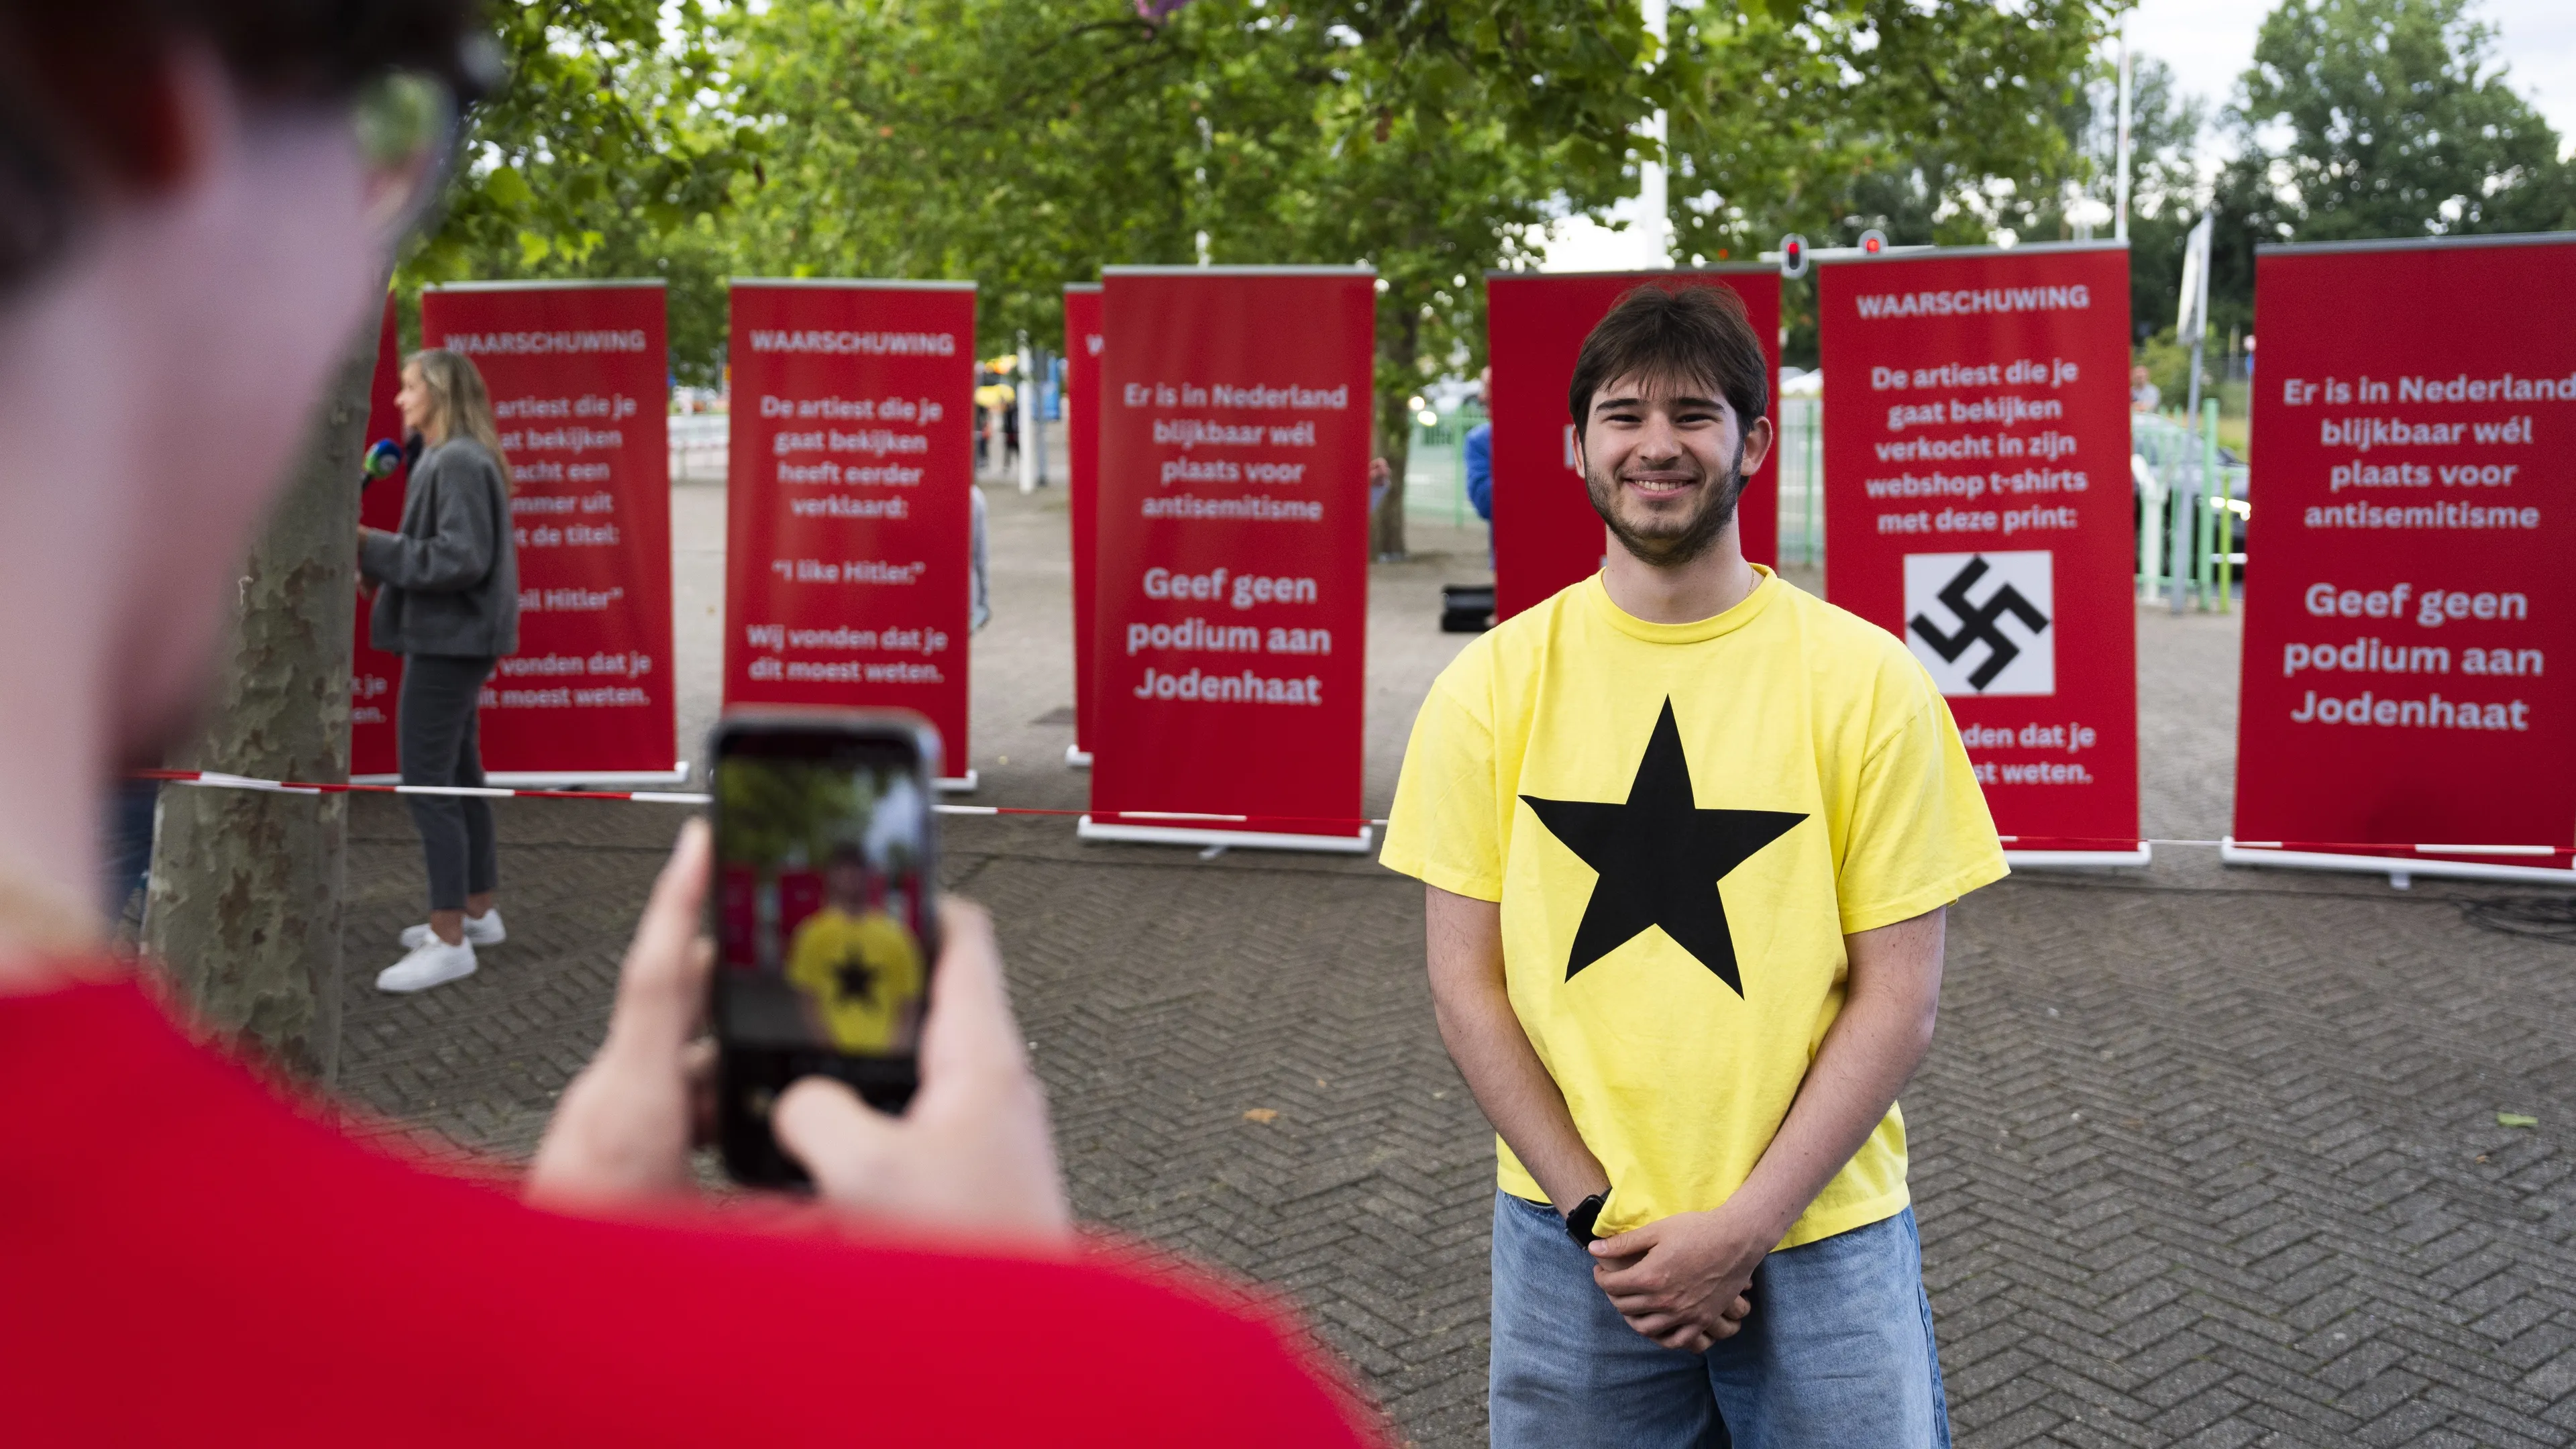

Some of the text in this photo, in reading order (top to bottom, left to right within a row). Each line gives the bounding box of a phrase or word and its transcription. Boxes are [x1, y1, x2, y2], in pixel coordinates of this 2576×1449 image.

[1856, 284, 2091, 319] WAARSCHUWING
[443, 330, 647, 354] WAARSCHUWING
[749, 330, 955, 356] WAARSCHUWING
[1871, 357, 2080, 390] De artiest die je
[1123, 382, 1348, 410] Er is in Nederland
[2283, 372, 2576, 405] Er is in Nederland
[492, 394, 637, 421] artiest die je
[759, 394, 943, 426] De artiest die je
[1887, 395, 2063, 434] gaat bekijken
[500, 427, 623, 454] at bekijken
[773, 429, 928, 458] gaat bekijken
[1152, 419, 1316, 449] blijkbaar wél
[1875, 431, 2077, 462] verkocht in zijn
[2320, 415, 2532, 452] blijkbaar wél
[512, 460, 610, 483] acht een
[777, 460, 924, 486] heeft eerder
[1161, 456, 1306, 485] plaats voor
[1865, 467, 2089, 500] webshop t-shirts
[2330, 459, 2518, 492] plaats voor
[511, 491, 614, 516] mmer uit
[789, 494, 908, 519] verklaard:
[1141, 493, 1324, 521] antisemitisme
[2304, 500, 2540, 529] antisemitisme
[1877, 504, 2078, 535] met deze print:
[531, 525, 562, 547] de
[564, 523, 619, 546] titel:
[795, 558, 841, 584] like
[1143, 567, 1318, 610] Geef geen
[2305, 582, 2528, 627] Geef geen
[746, 624, 949, 655] Wij vonden dat je
[1127, 617, 1332, 655] podium aan
[499, 650, 652, 679] vonden dat je
[748, 656, 944, 683] dit moest weten.
[2283, 637, 2544, 677] podium aan
[477, 686, 650, 708] it moest weten.
[1134, 667, 1322, 705] Jodenhaat
[2290, 690, 2529, 731] Jodenhaat
[1961, 722, 2096, 753] den dat je
[2001, 761, 2093, 784] weten.
